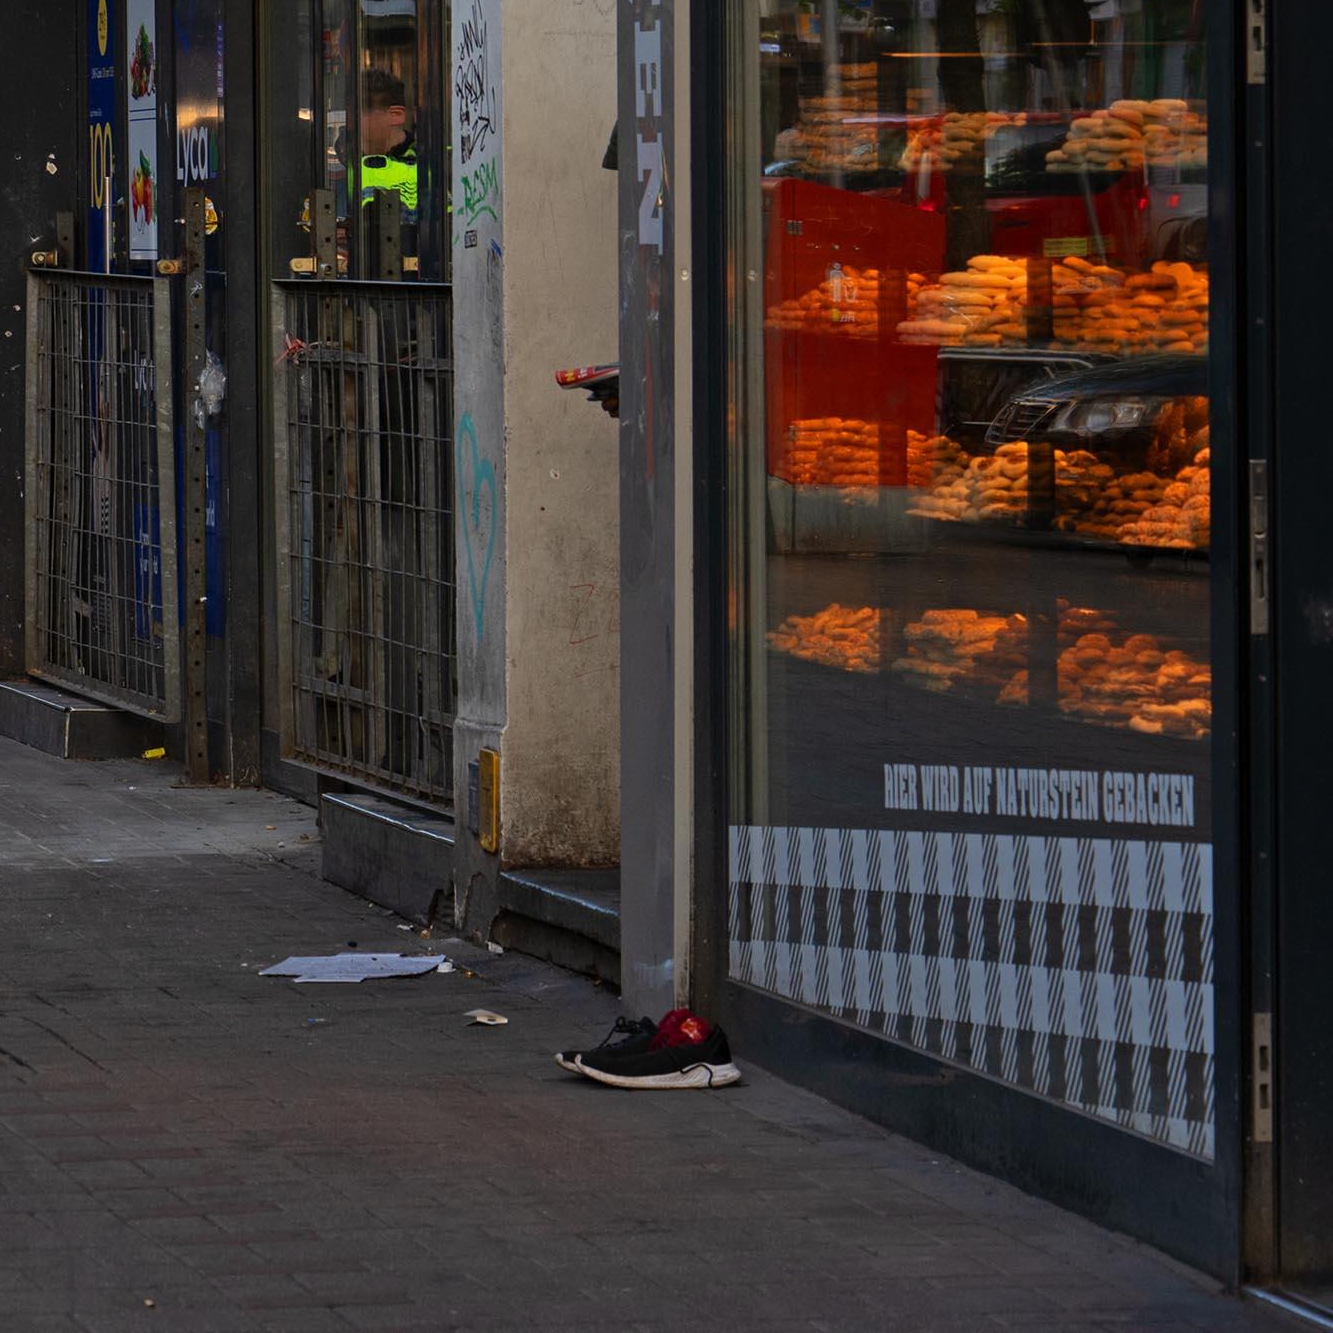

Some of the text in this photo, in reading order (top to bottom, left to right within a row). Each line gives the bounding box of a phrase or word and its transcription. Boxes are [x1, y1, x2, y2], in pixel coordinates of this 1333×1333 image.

[176, 126, 209, 188] Lyca
[883, 763, 1194, 827] HIER WIRD AUF NATURSTEIN GEBACKEN
